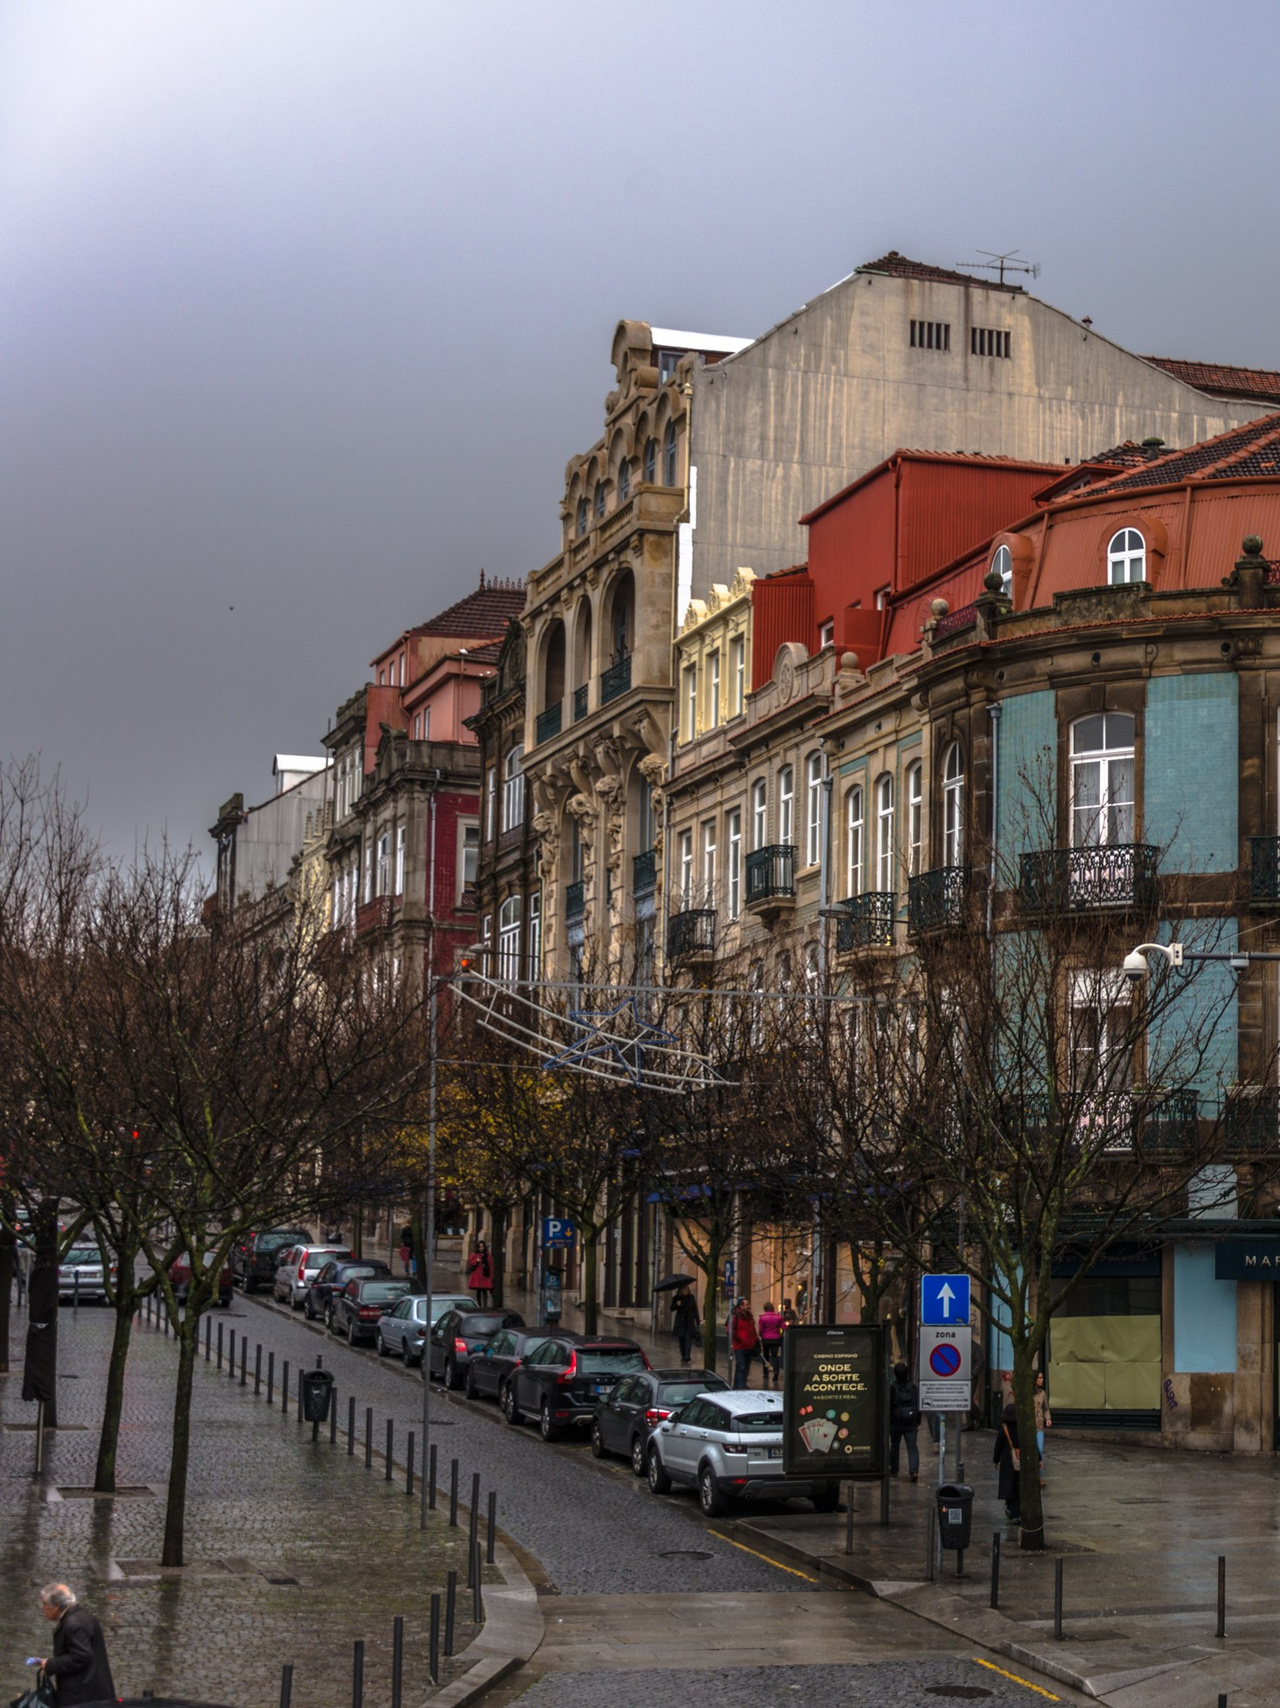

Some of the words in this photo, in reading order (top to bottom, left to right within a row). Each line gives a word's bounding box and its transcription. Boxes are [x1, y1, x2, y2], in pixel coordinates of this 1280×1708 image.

[549, 1221, 561, 1237] P
[819, 1364, 851, 1372] ONDE
[804, 1383, 867, 1392] ACONTECE.
